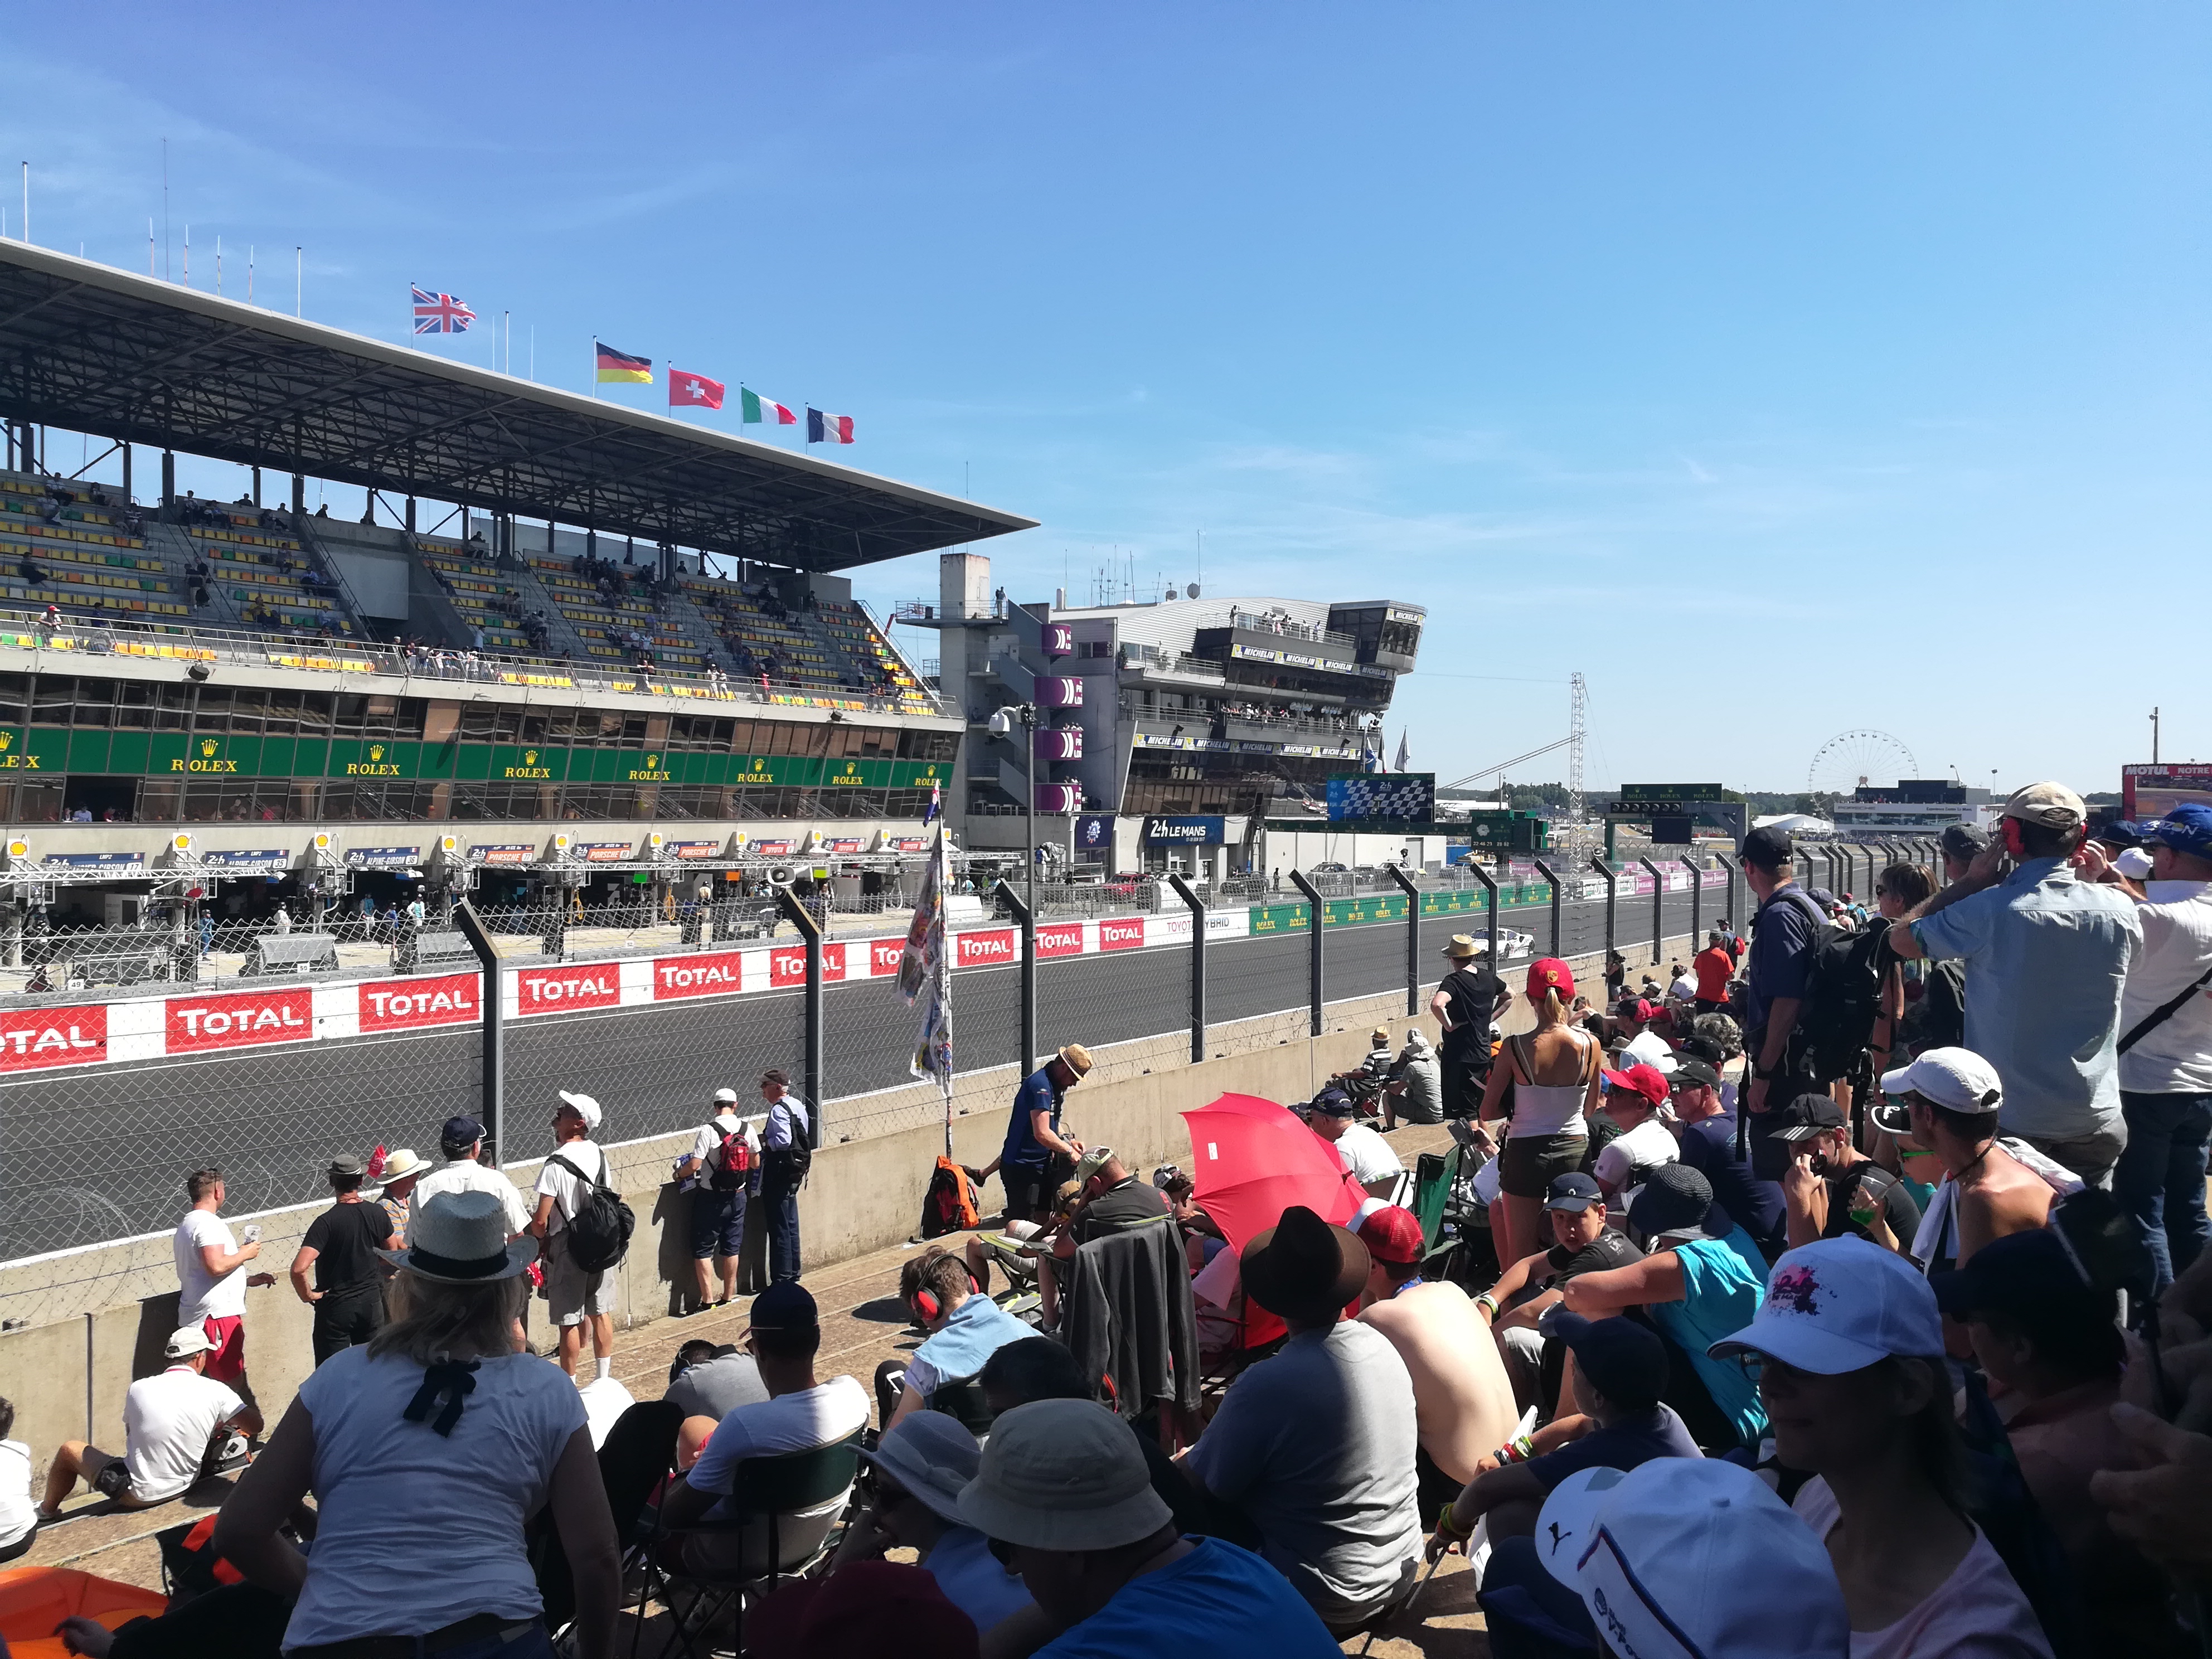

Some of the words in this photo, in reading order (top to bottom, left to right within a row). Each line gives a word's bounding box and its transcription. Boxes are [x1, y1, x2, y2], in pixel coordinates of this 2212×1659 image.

[1395, 612, 1419, 620] MICHELIN
[1244, 647, 1275, 659] MICHELIN
[1286, 655, 1316, 666] MICHELIN
[1325, 661, 1352, 672] MICHELIN
[1362, 666, 1387, 677] MICHELIN
[1148, 736, 1183, 746] MICHELIN
[1196, 740, 1230, 749] MICHELIN
[1242, 743, 1273, 751] MICHELIN
[171, 759, 237, 772] ROLEX
[347, 763, 400, 775] ROLEX
[2125, 766, 2170, 775] MOTUL
[505, 767, 551, 778] ROLEX
[629, 770, 671, 780] ROLEX
[737, 773, 773, 783] ROLEX
[832, 776, 864, 785] ROLEX
[1169, 827, 1181, 837] LE
[1181, 826, 1206, 836] MANS
[366, 856, 406, 865] ALPINE-GIBSON
[488, 853, 521, 861] PORSCHE
[1167, 920, 1194, 932] TOYOT
[1205, 917, 1229, 929] YBRID
[1256, 920, 1276, 930] ROLEX
[1289, 917, 1307, 926] ROLEX
[1103, 926, 1142, 942] TOTAL
[1037, 933, 1080, 948] TOTAL
[961, 939, 1011, 957] TOTAL
[660, 966, 736, 988] TOTAL
[526, 977, 614, 1001] TOTAL
[368, 991, 472, 1017] TOTAL
[177, 1006, 304, 1036] TOTAL
[0, 1026, 96, 1054] TAL
